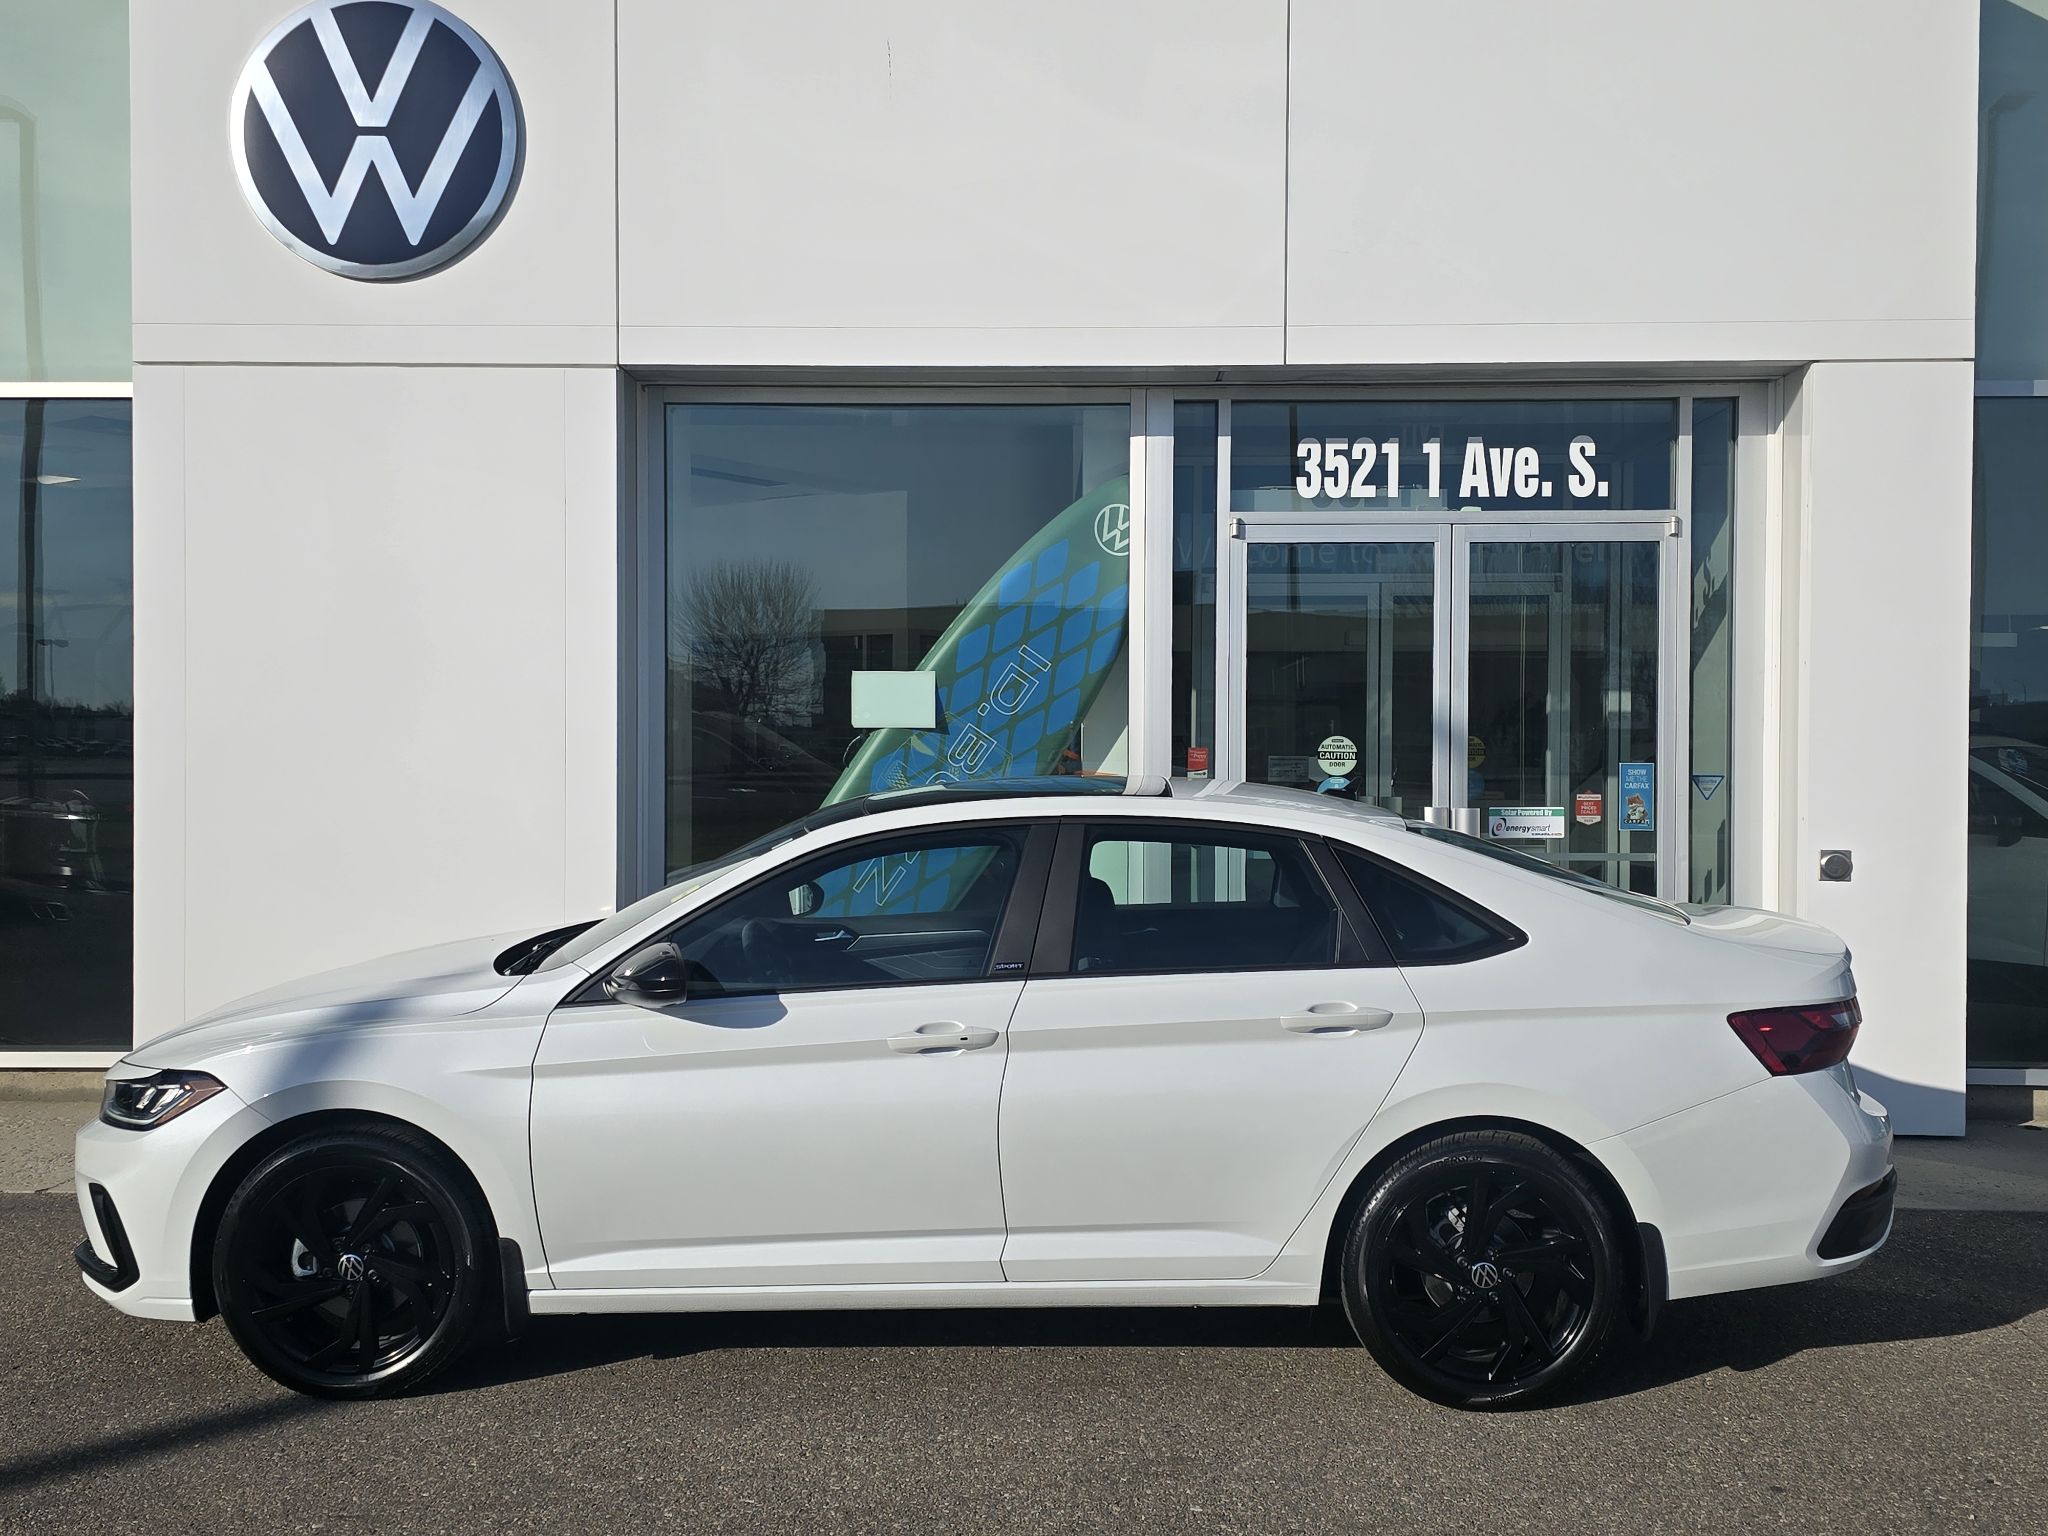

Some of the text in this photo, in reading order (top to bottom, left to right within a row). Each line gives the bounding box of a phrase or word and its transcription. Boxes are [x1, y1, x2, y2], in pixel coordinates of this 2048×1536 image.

[240, 0, 506, 250] VW
[1296, 435, 1609, 499] 3521 1 Ave. S.
[1319, 752, 1356, 760] CAUTION
[1544, 809, 1553, 817] By
[1505, 824, 1551, 833] energysmart
